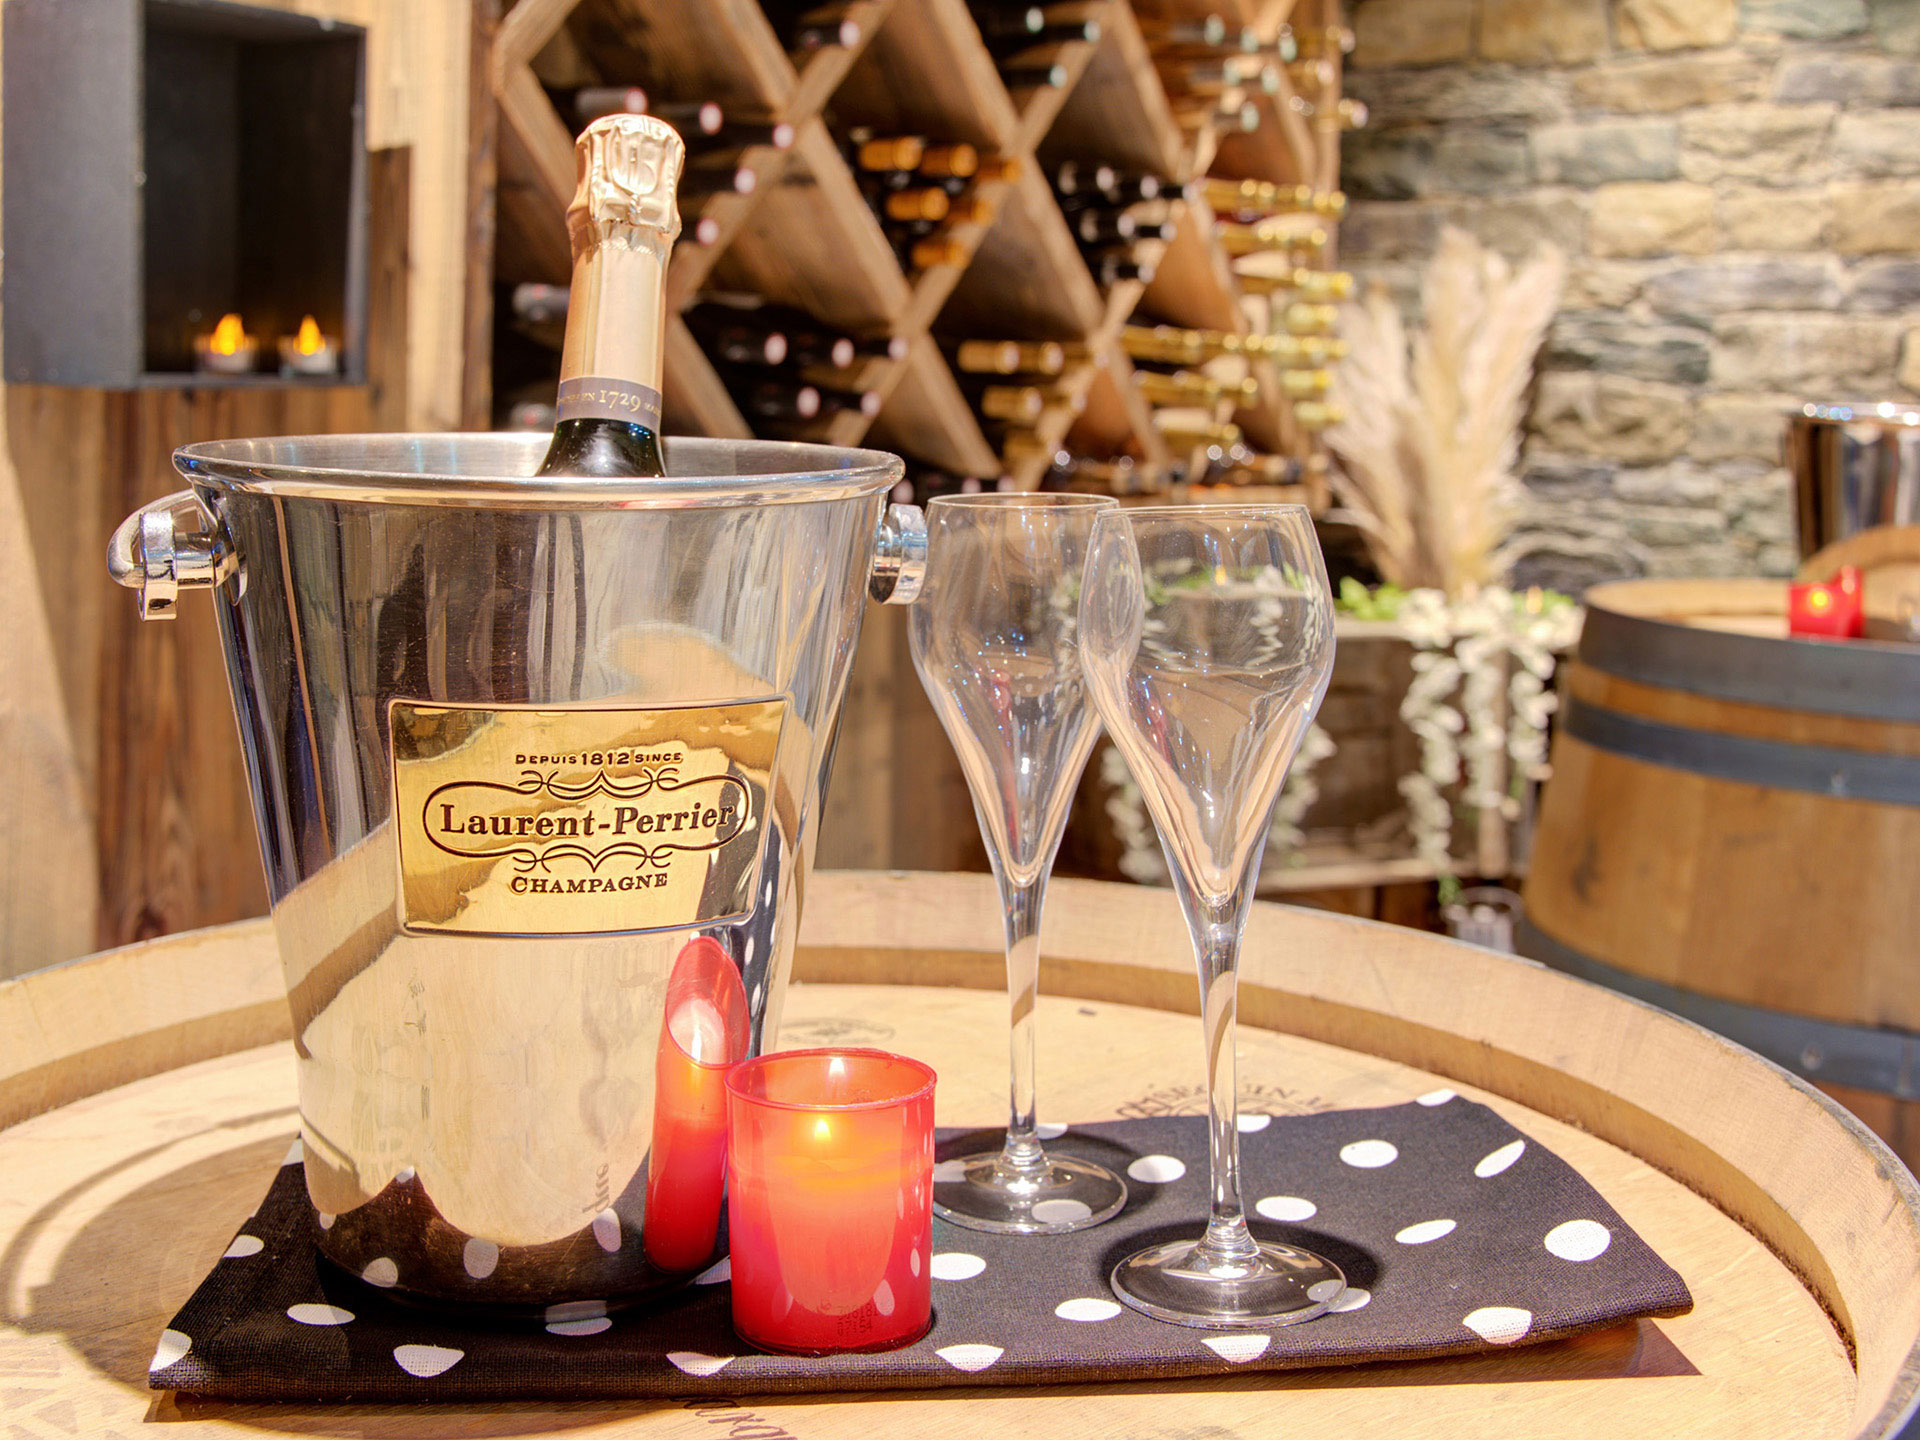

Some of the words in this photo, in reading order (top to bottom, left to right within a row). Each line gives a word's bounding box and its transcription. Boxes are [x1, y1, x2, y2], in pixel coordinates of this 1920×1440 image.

[598, 389, 641, 413] 1729
[515, 754, 577, 765] DEPUIS
[582, 752, 630, 766] 1812
[634, 752, 683, 764] SINCE
[440, 802, 735, 837] Laurent-Perrier
[510, 873, 669, 894] CHAMPAGNE
